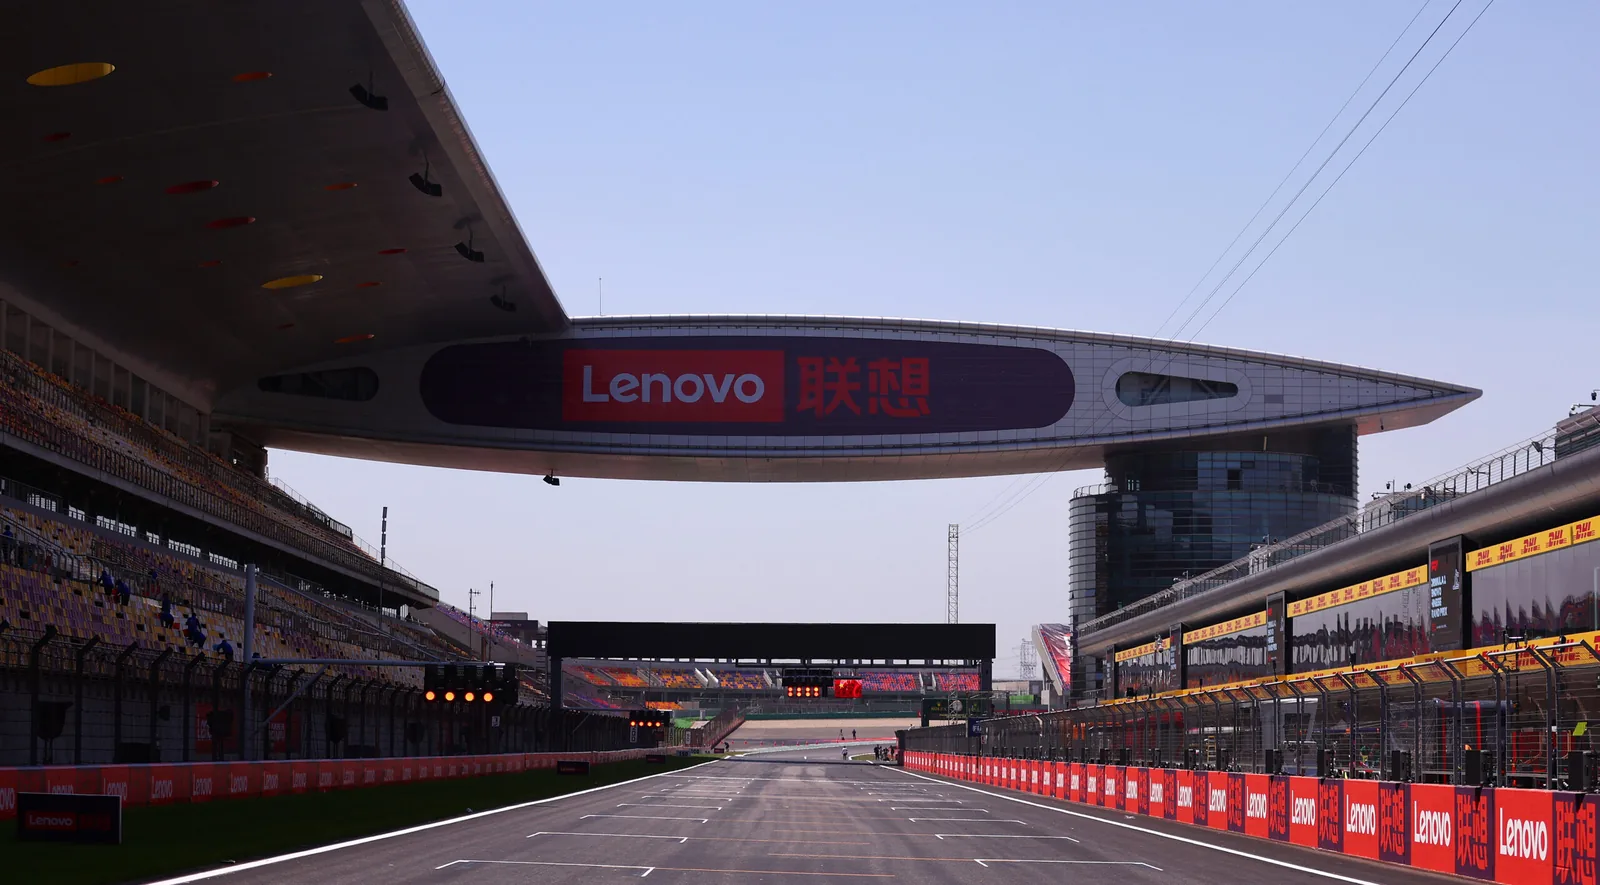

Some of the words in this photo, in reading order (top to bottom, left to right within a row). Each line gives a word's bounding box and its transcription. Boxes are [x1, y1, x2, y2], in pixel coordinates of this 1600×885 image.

[582, 364, 765, 404] Lenovo
[796, 357, 930, 418] 联想
[151, 775, 173, 799] Lenovo
[192, 773, 212, 796] Lenovo
[230, 771, 248, 793] Lenovo
[1149, 777, 1163, 803] Lenovo
[1177, 780, 1192, 808] Lenovo
[1209, 782, 1226, 813] Lenovo
[1246, 786, 1267, 819] Lenovo
[1291, 790, 1316, 826] Lenovo
[1346, 794, 1376, 836] Lenovo
[29, 814, 73, 826] Lenovo
[1414, 800, 1451, 847] Lenovo
[1457, 794, 1488, 870] 联想
[1500, 807, 1548, 861] Lenovo
[1555, 801, 1596, 885] 联想
